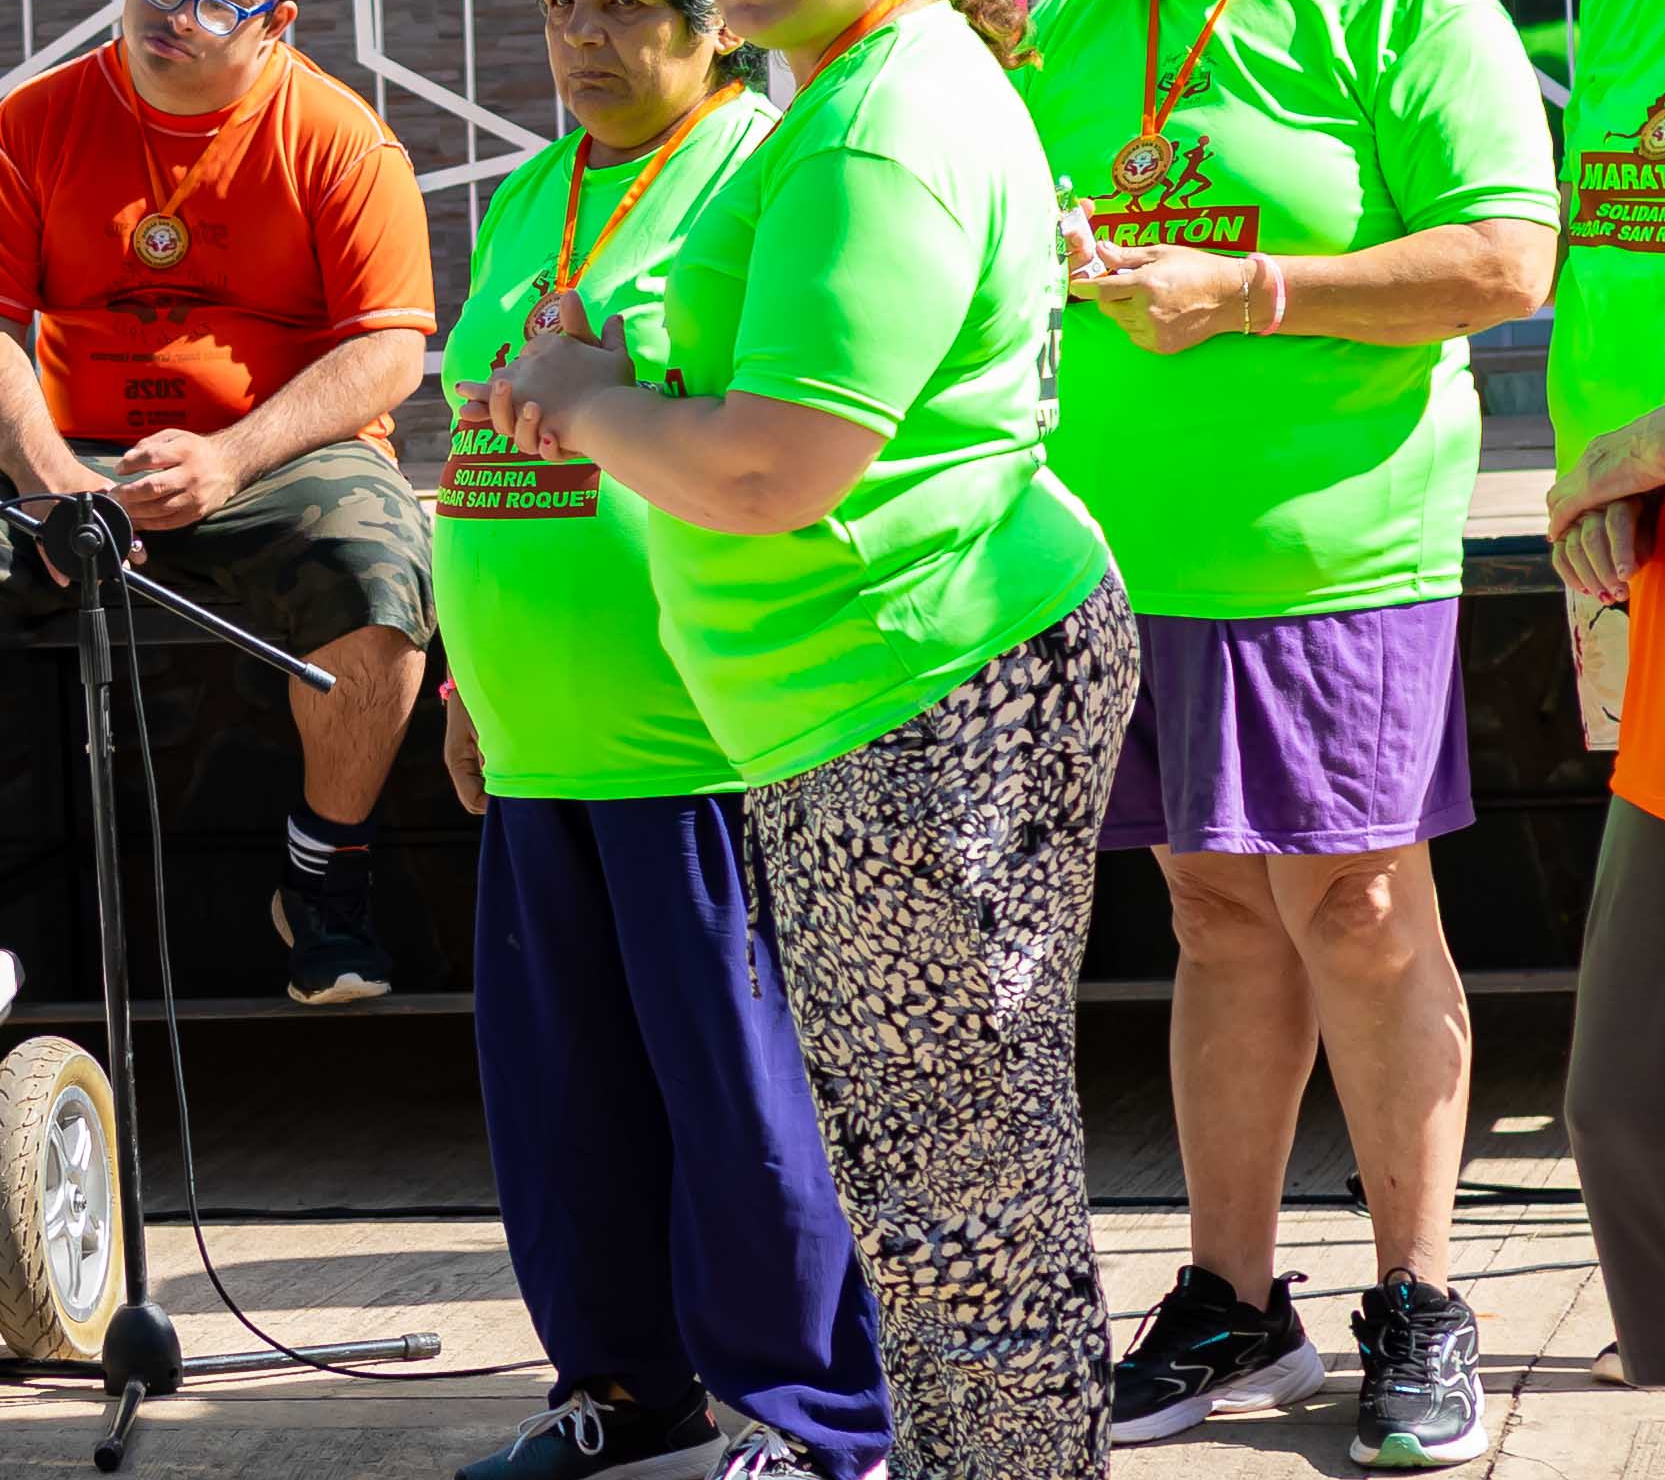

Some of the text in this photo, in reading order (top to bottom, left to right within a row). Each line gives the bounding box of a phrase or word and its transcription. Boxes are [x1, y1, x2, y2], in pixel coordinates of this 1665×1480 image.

[1095, 209, 1244, 247] ARATÓN
[1617, 226, 1655, 242] SAN
[454, 469, 537, 487] SOLIDARIA
[466, 490, 500, 508] SAN
